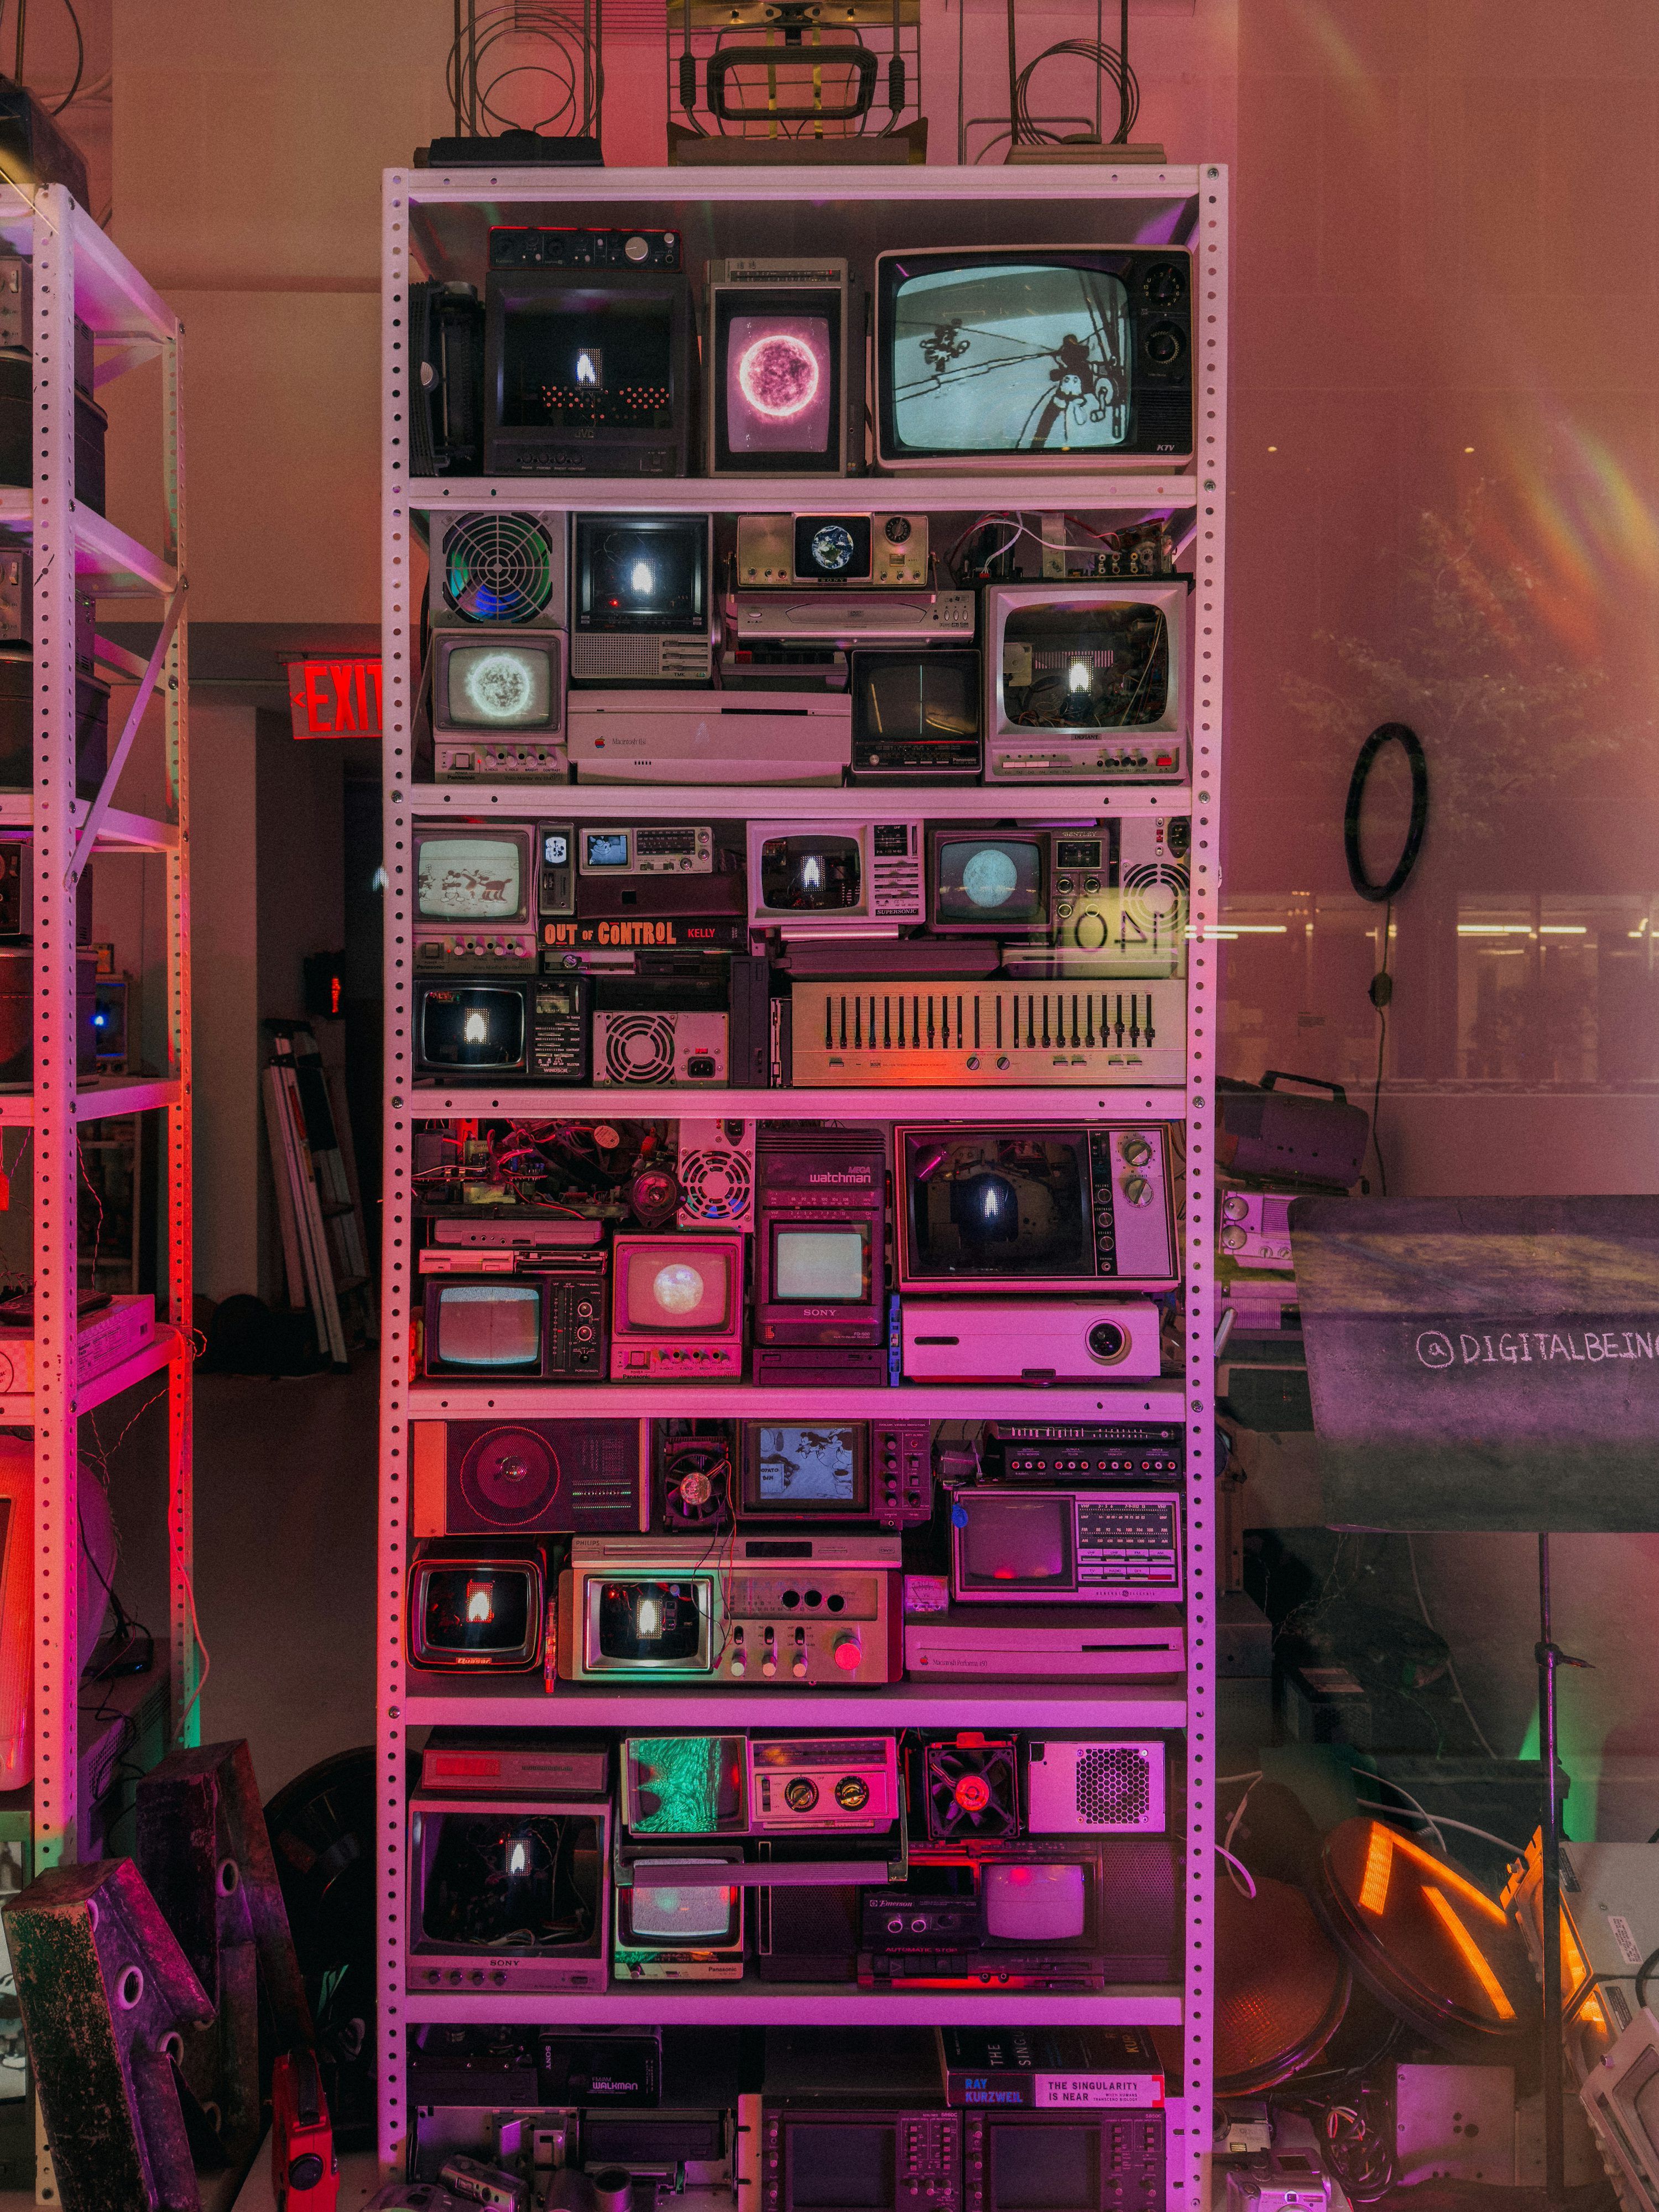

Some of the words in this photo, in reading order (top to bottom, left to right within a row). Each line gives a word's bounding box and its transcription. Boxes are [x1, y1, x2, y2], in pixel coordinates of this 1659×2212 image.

[575, 429, 594, 437] JVC
[304, 665, 382, 732] EXIT
[545, 924, 578, 945] OUT
[582, 930, 593, 941] OF
[598, 922, 676, 945] CONTROL
[687, 928, 715, 938] KELLY
[810, 1172, 871, 1183] watchman
[1416, 1330, 1659, 1369] @DIGITALBEIN
[1011, 1427, 1039, 1438] being
[1046, 1427, 1083, 1438] digital
[879, 1900, 914, 1908] Emerson
[988, 2044, 1004, 2066] THE
[592, 2081, 638, 2090] WALKMAN
[965, 2079, 988, 2090] RAY
[1048, 2081, 1068, 2090] THE
[1072, 2081, 1138, 2091] SINGULARITY
[965, 2091, 1024, 2104] KURZWEIL
[1048, 2093, 1058, 2101] IS
[1062, 2093, 1089, 2101] NEAR
